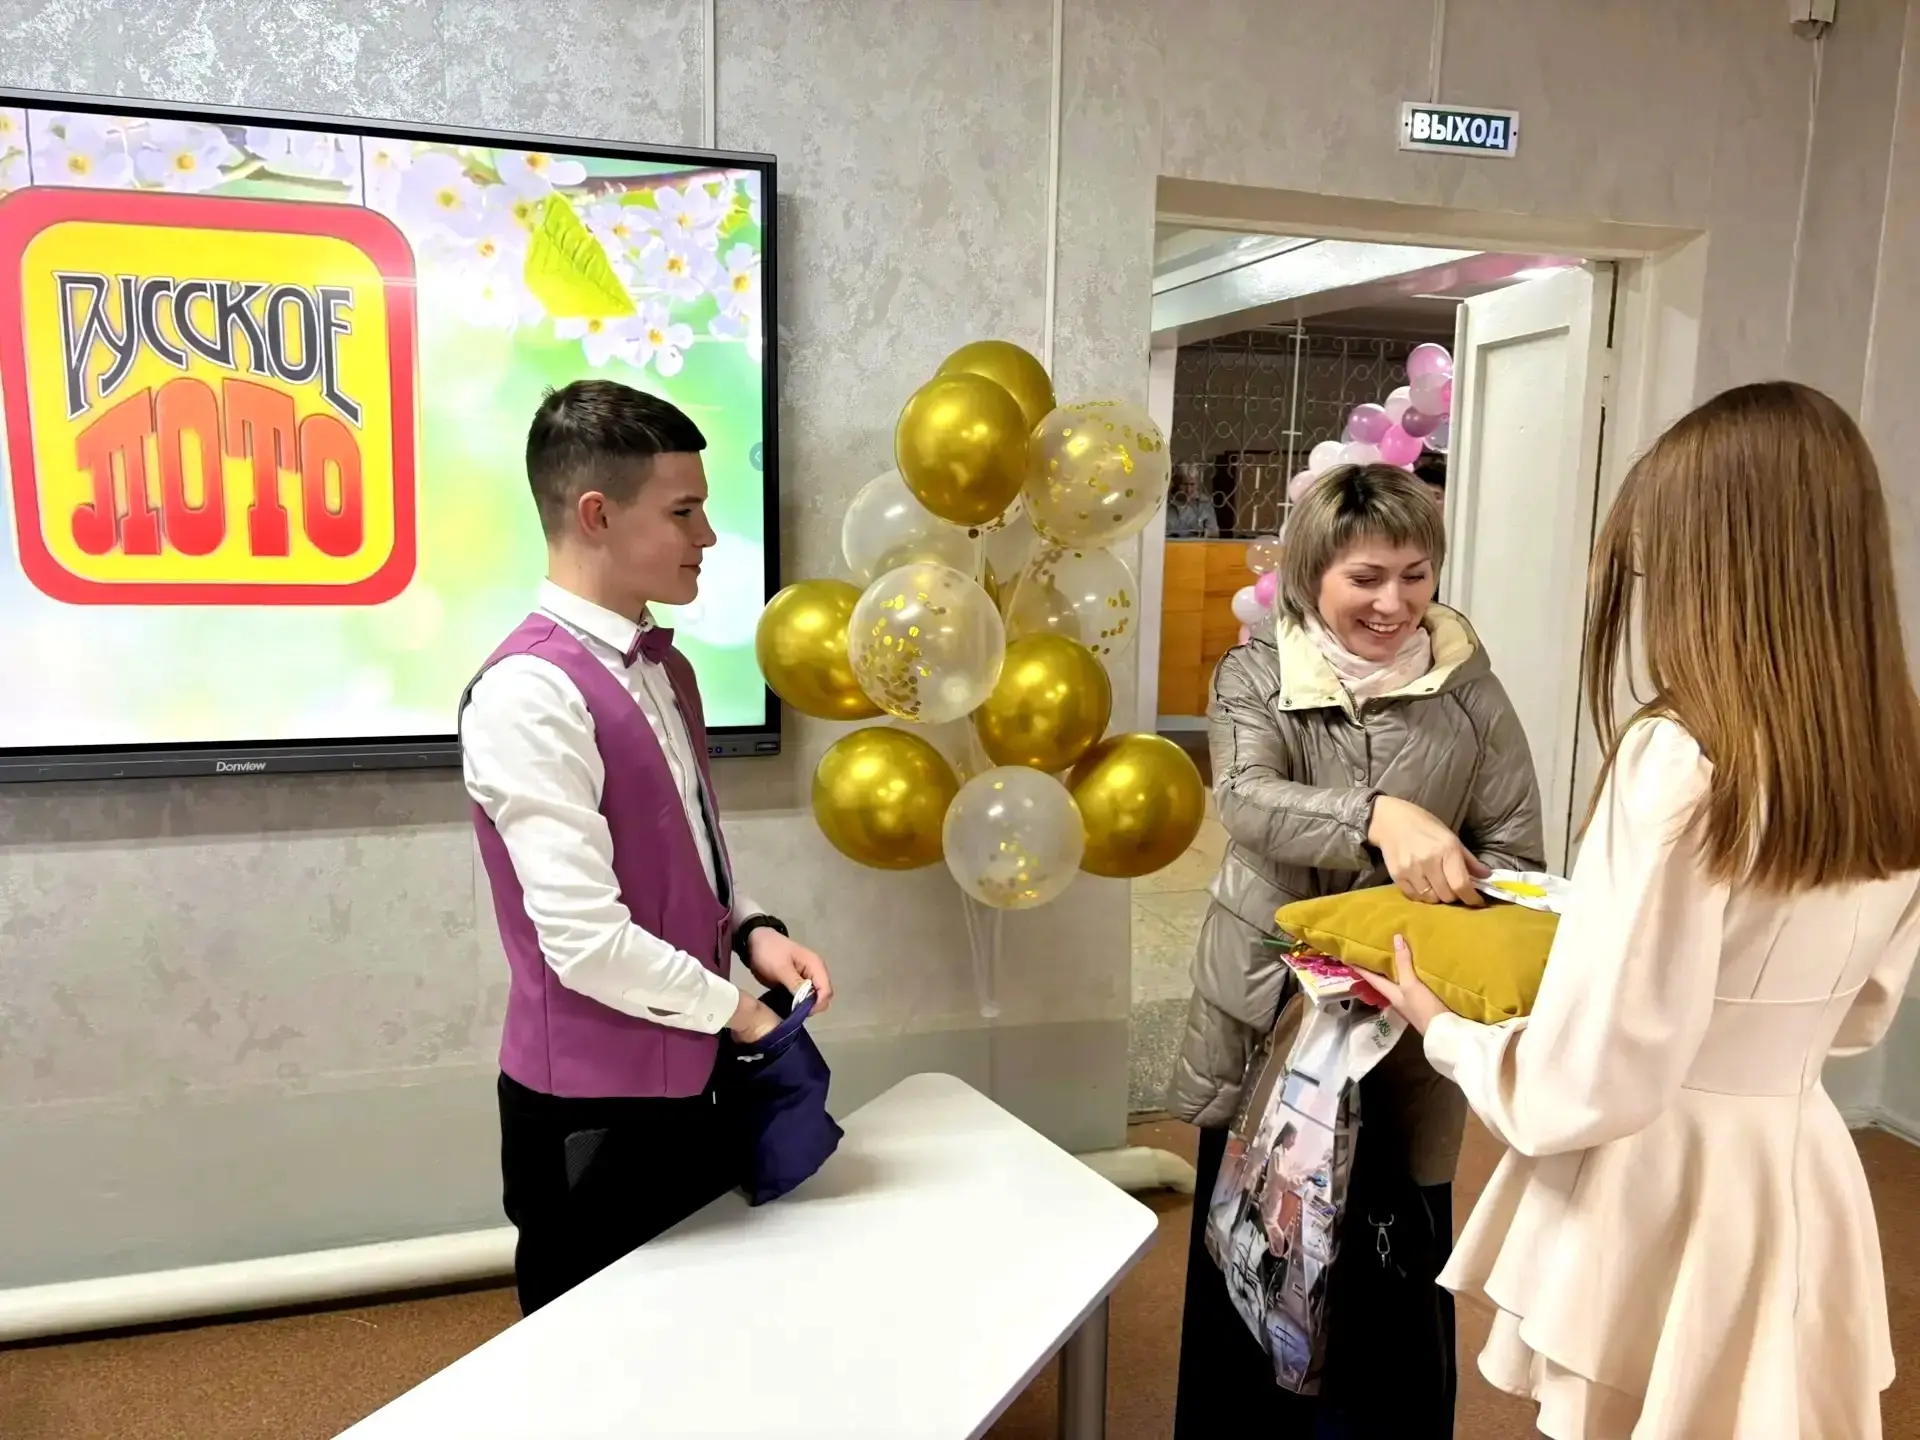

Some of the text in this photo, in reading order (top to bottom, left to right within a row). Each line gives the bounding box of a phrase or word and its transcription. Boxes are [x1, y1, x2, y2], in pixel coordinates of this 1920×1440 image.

[1412, 112, 1505, 148] ВЫХОД
[52, 271, 363, 430] РУССКОЕ
[71, 377, 364, 558] ЛОТО
[215, 761, 267, 772] Donview
